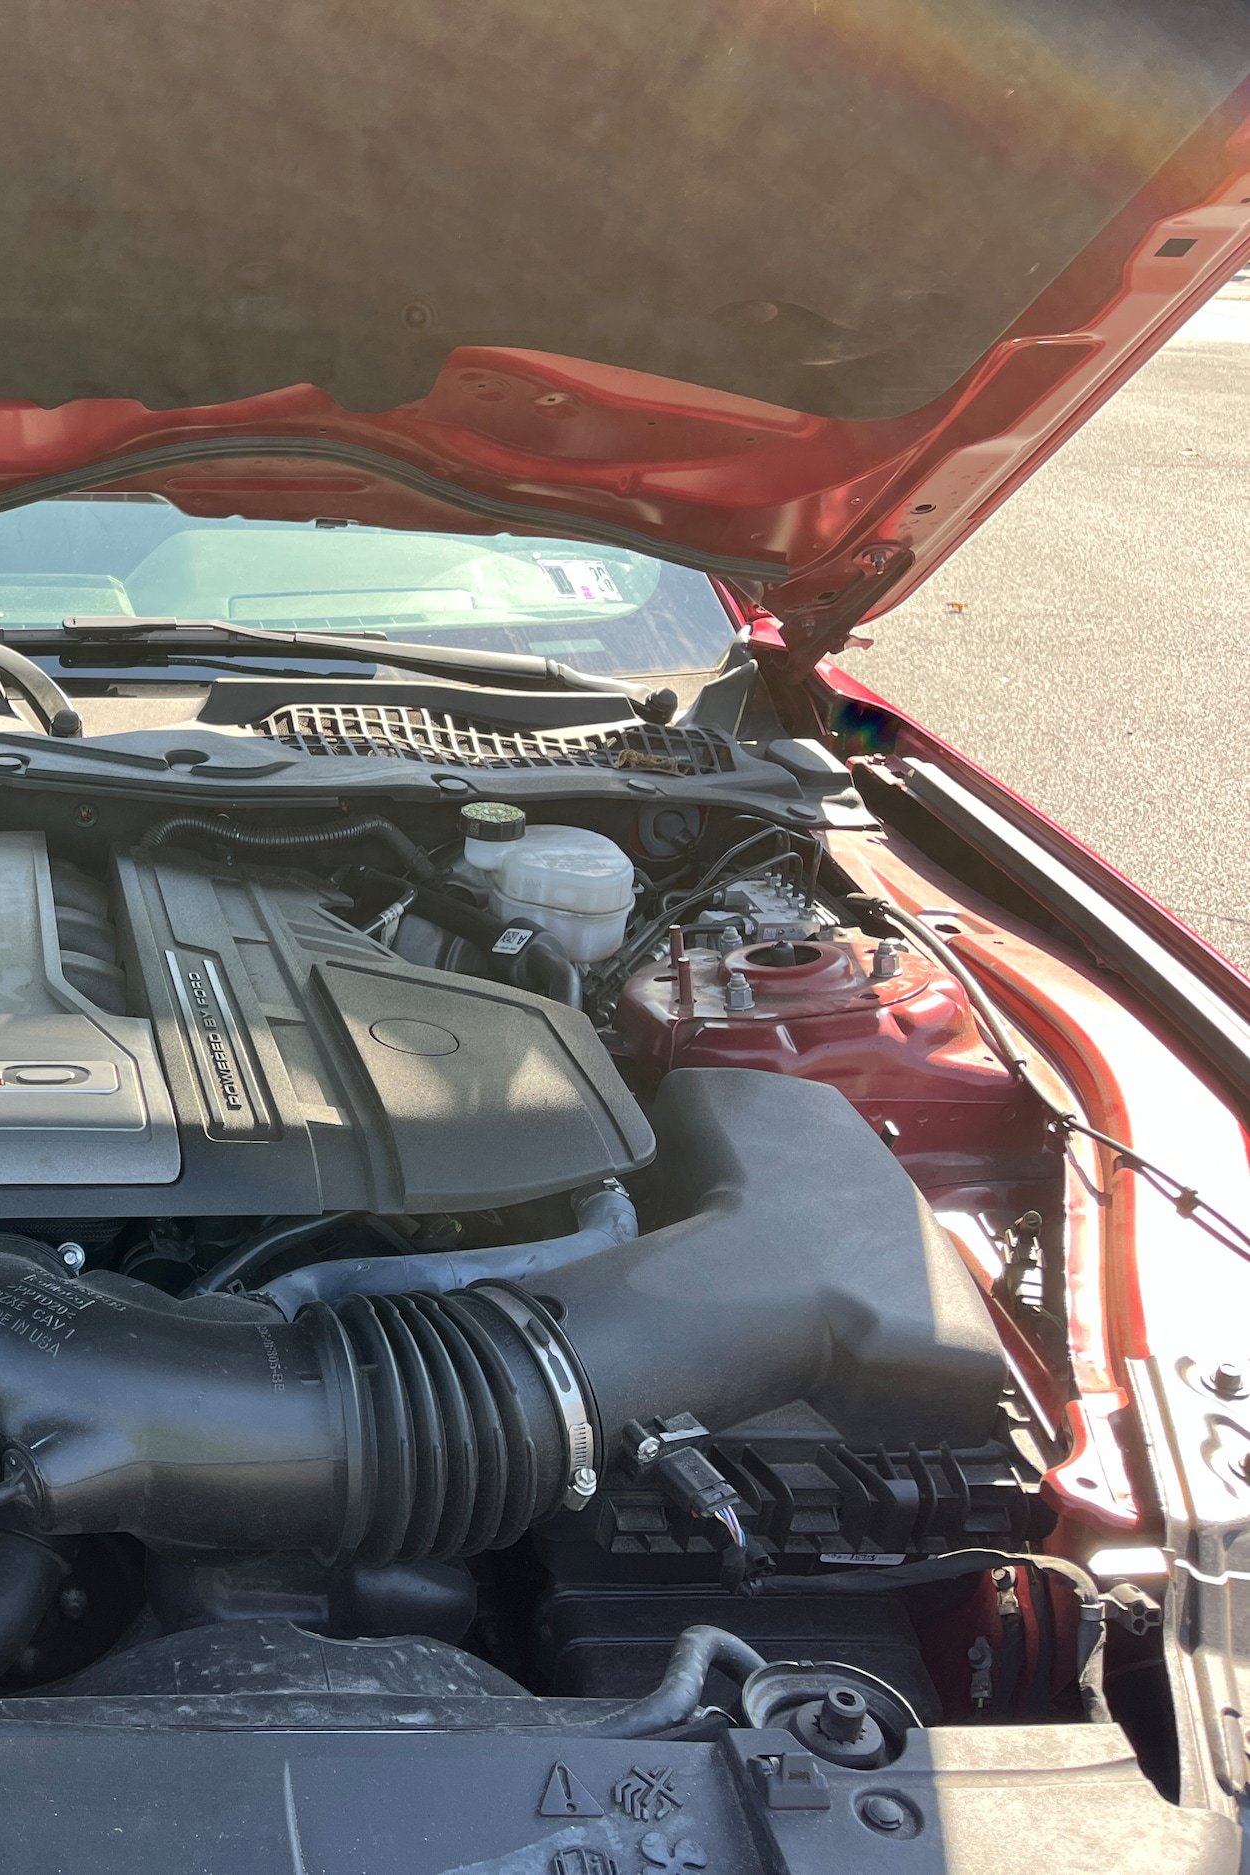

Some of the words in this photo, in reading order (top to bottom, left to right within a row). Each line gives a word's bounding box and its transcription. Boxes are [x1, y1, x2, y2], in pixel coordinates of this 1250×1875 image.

[189, 972, 208, 1007] FORD
[201, 1010, 216, 1030] BY
[209, 1033, 241, 1109] POWERED
[10, 1318, 30, 1335] IN
[28, 1328, 61, 1359] USA
